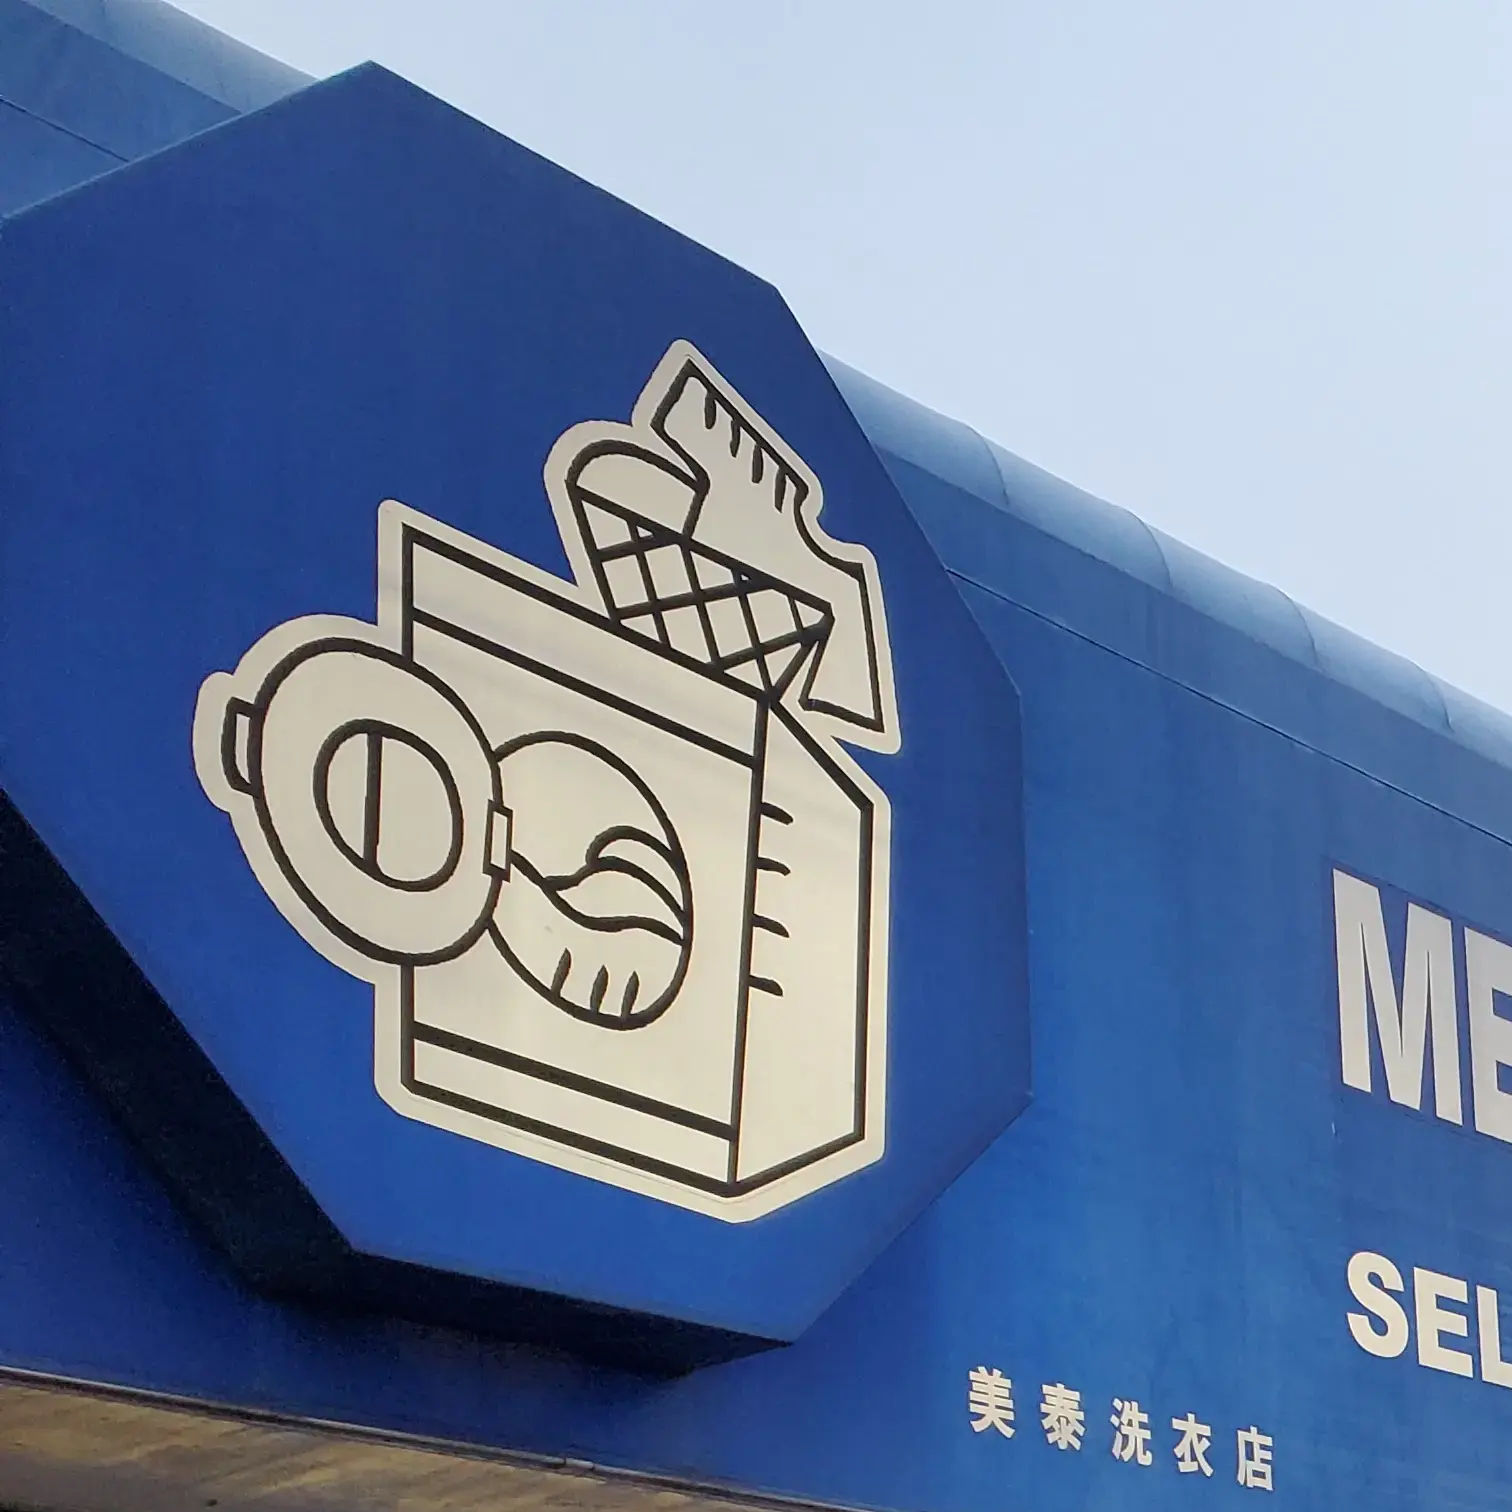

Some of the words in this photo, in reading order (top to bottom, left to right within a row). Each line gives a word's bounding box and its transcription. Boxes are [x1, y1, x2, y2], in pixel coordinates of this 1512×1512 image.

[968, 1365, 1275, 1491] 美泰洗衣店
